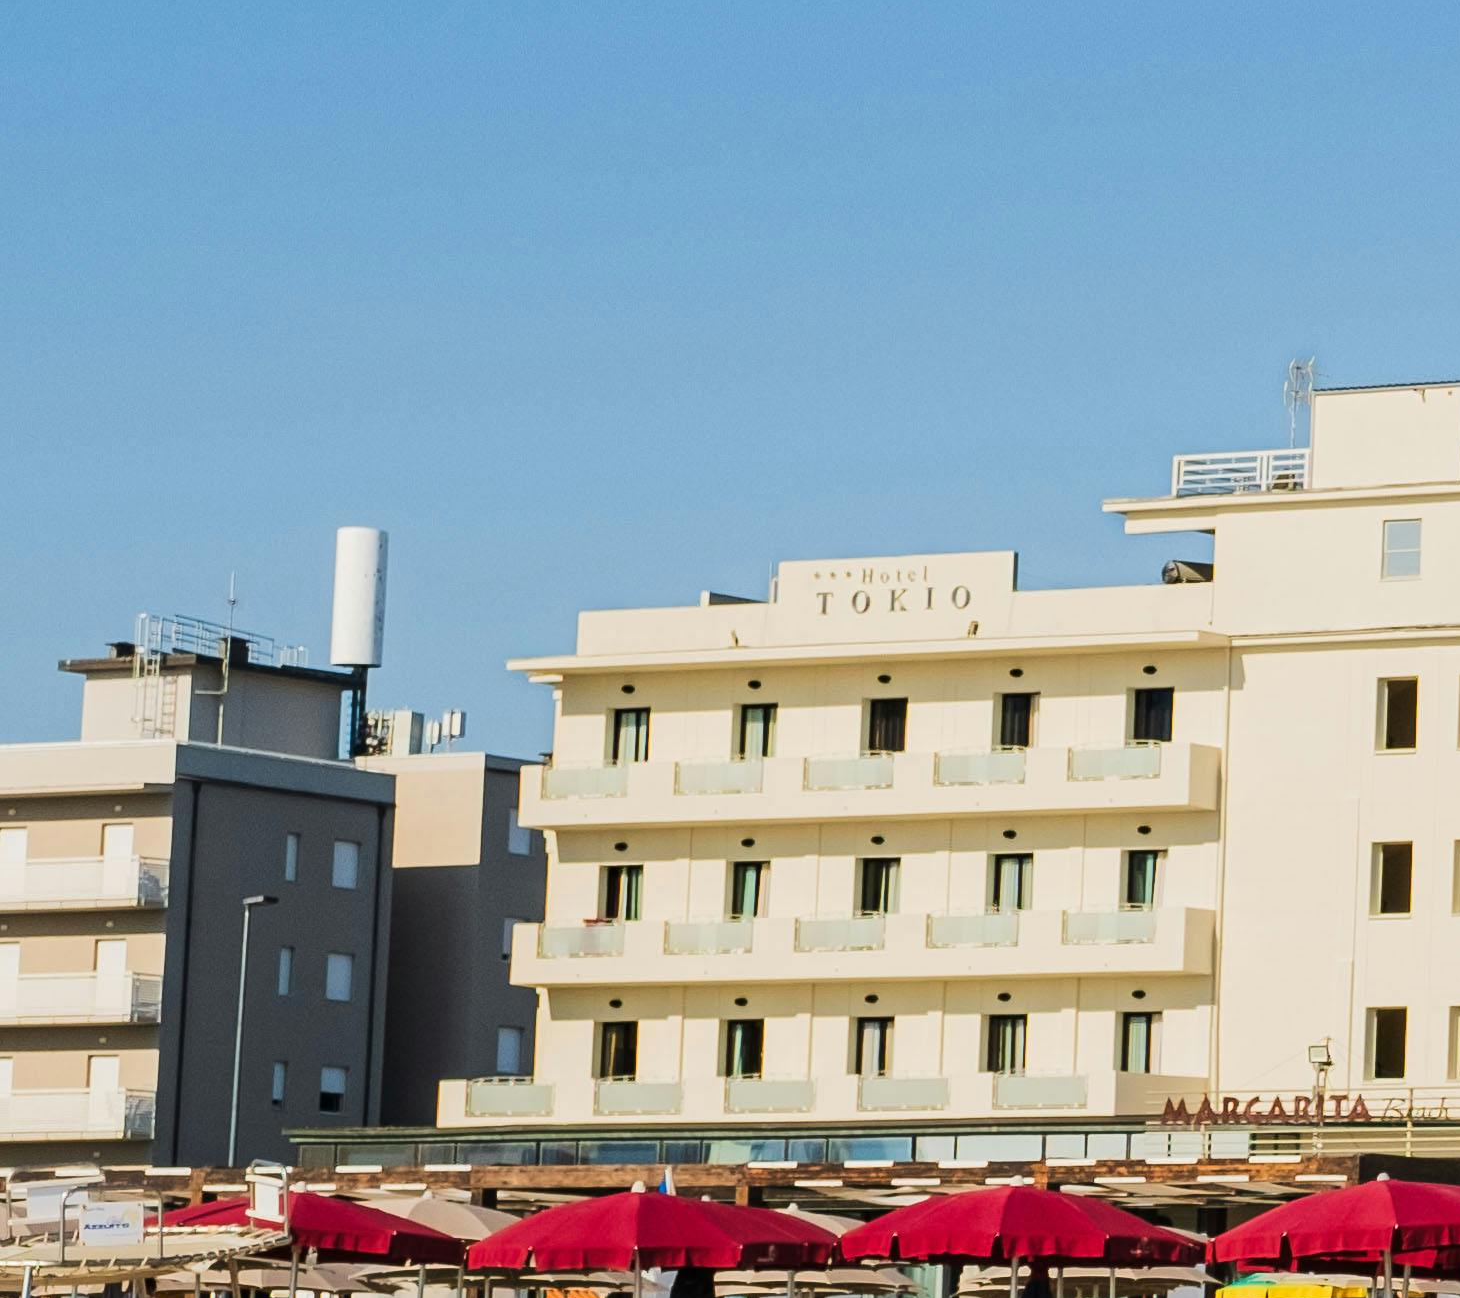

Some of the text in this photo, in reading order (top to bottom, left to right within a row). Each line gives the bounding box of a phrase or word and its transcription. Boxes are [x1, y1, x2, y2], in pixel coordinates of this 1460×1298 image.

[862, 566, 929, 584] Hotel
[816, 586, 972, 615] TOKIO
[1160, 1093, 1372, 1125] MARGARITA
